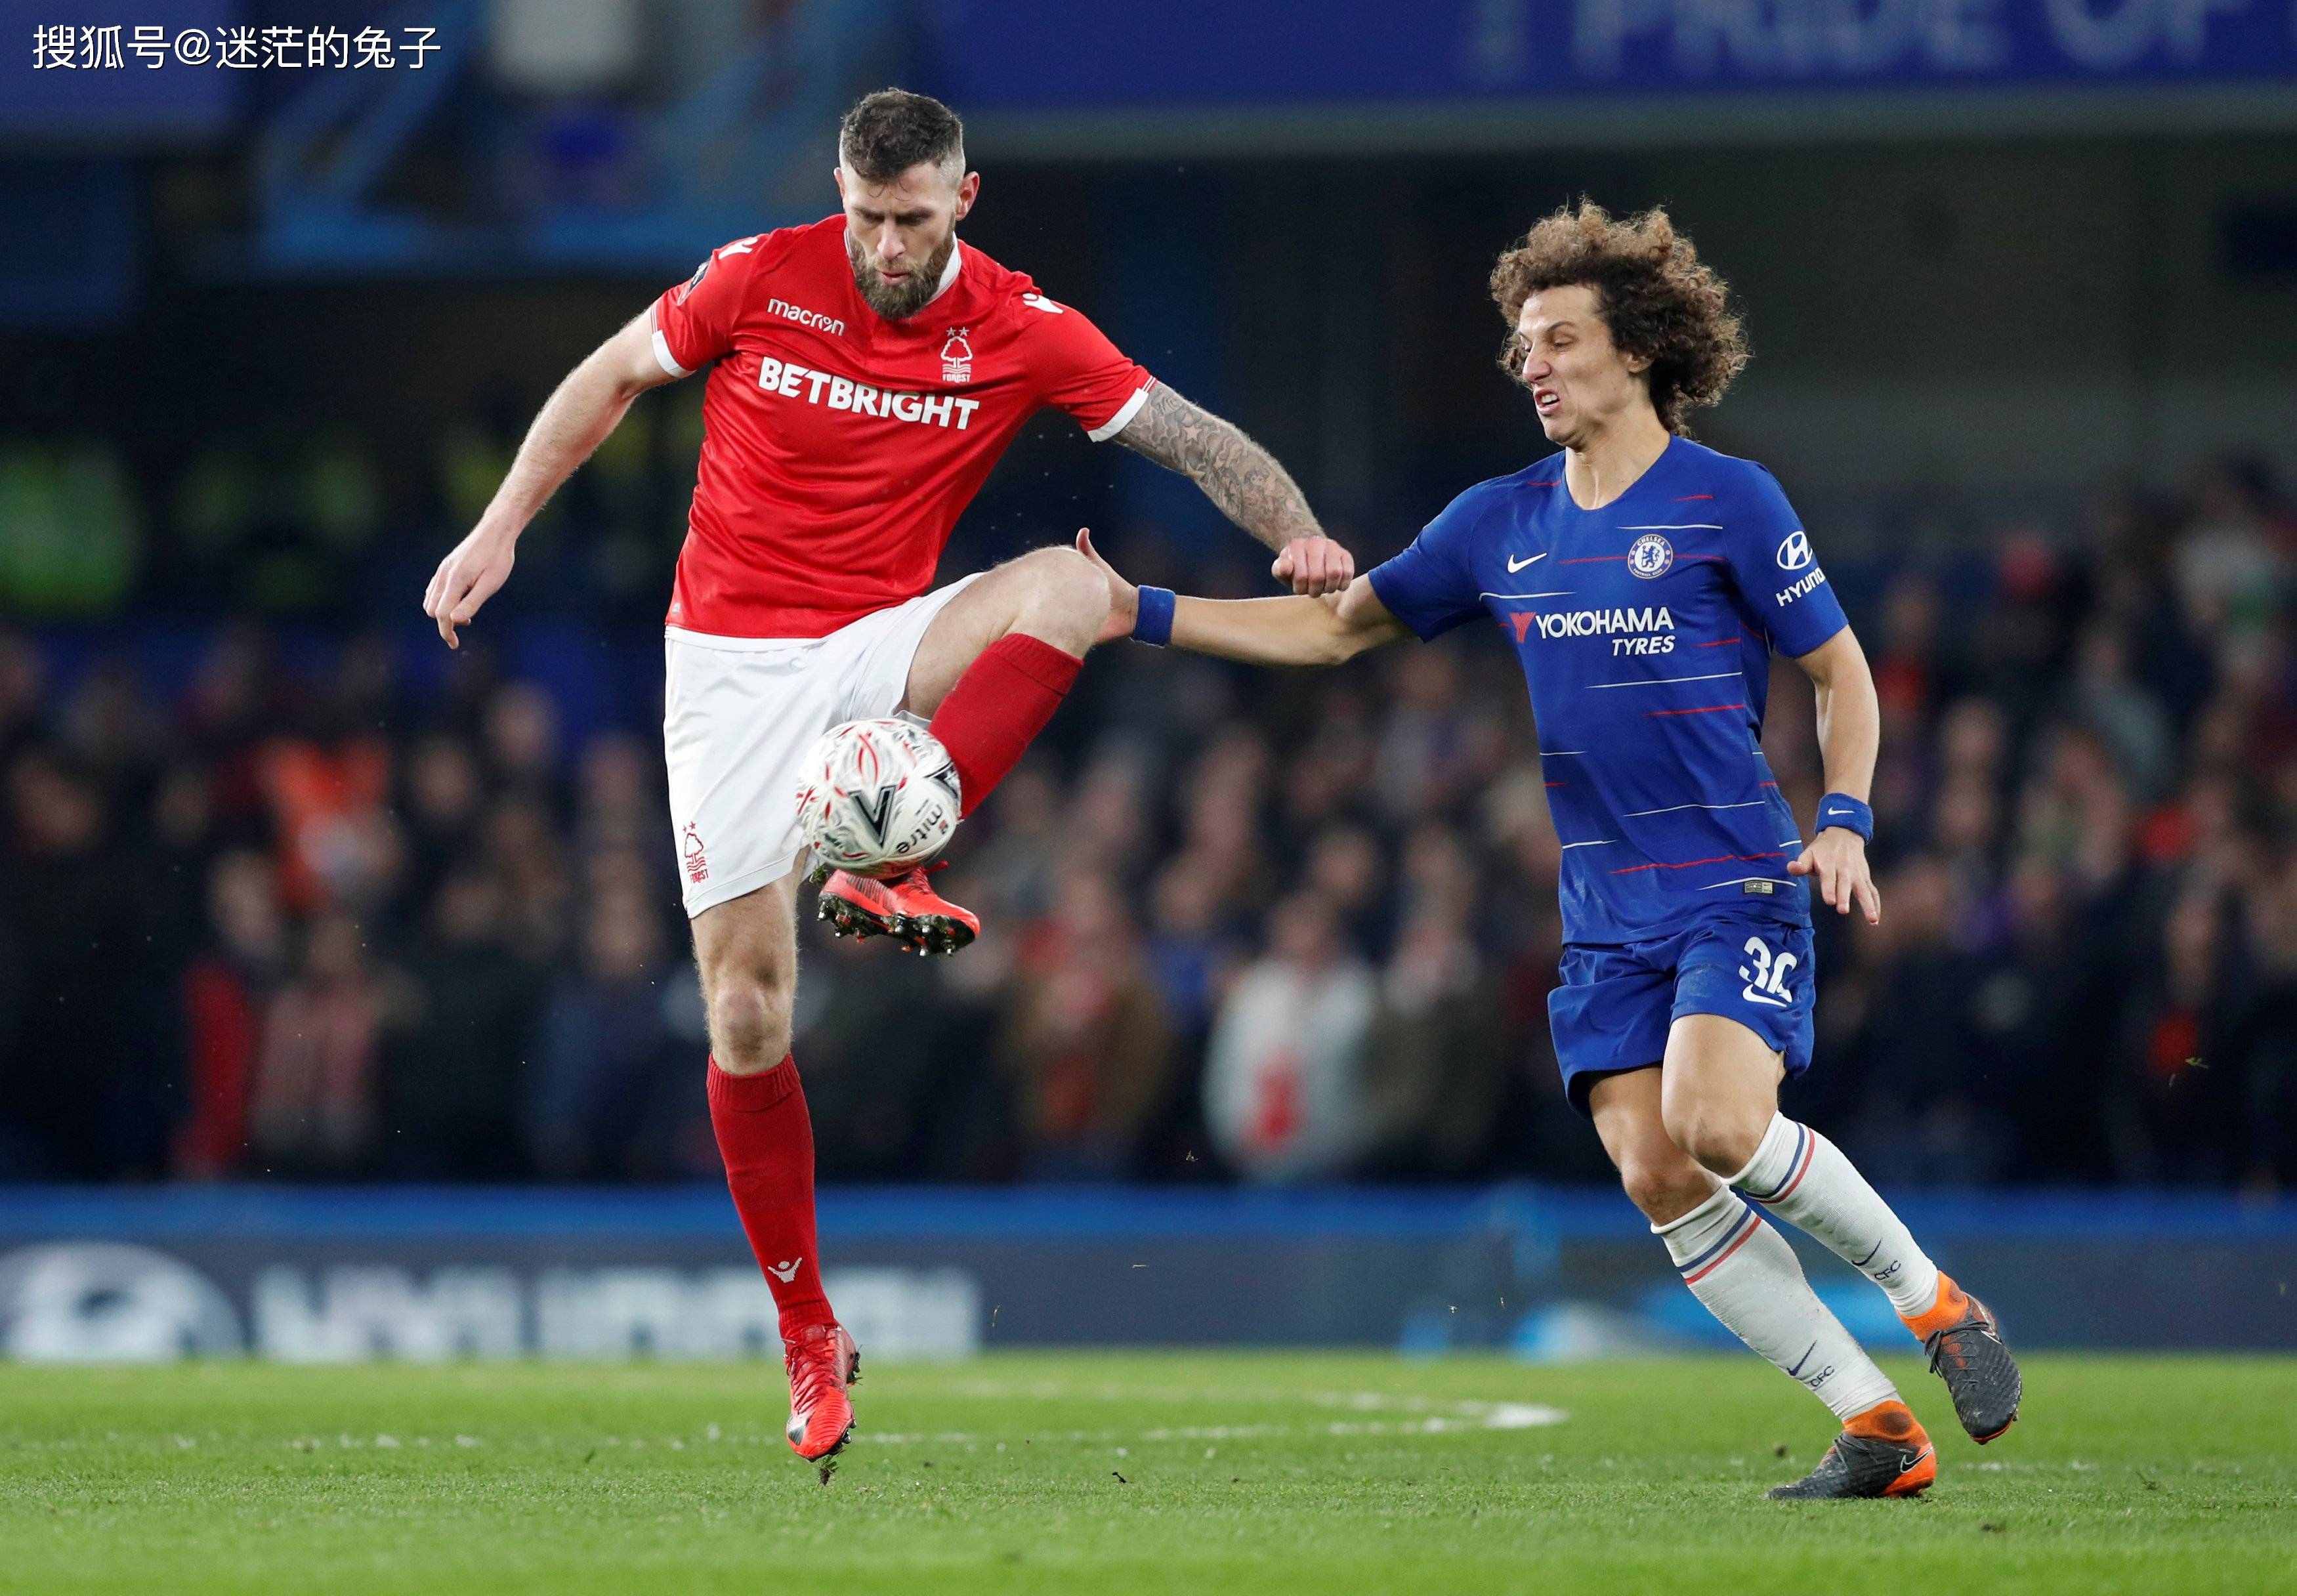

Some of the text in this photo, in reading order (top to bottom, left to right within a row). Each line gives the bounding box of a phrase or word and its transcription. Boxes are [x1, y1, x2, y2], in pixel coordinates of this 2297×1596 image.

[767, 298, 845, 336] macron
[759, 356, 979, 430] BETBRIGHT
[1637, 536, 1665, 546] CHELSEA
[1776, 567, 1826, 607] HYUND
[1535, 606, 1674, 639] YOKOHAMA
[1612, 635, 1675, 656] TYRES
[896, 805, 942, 853] mitre
[1874, 1260, 1901, 1280] CFC
[1810, 1366, 1834, 1387] CFC
